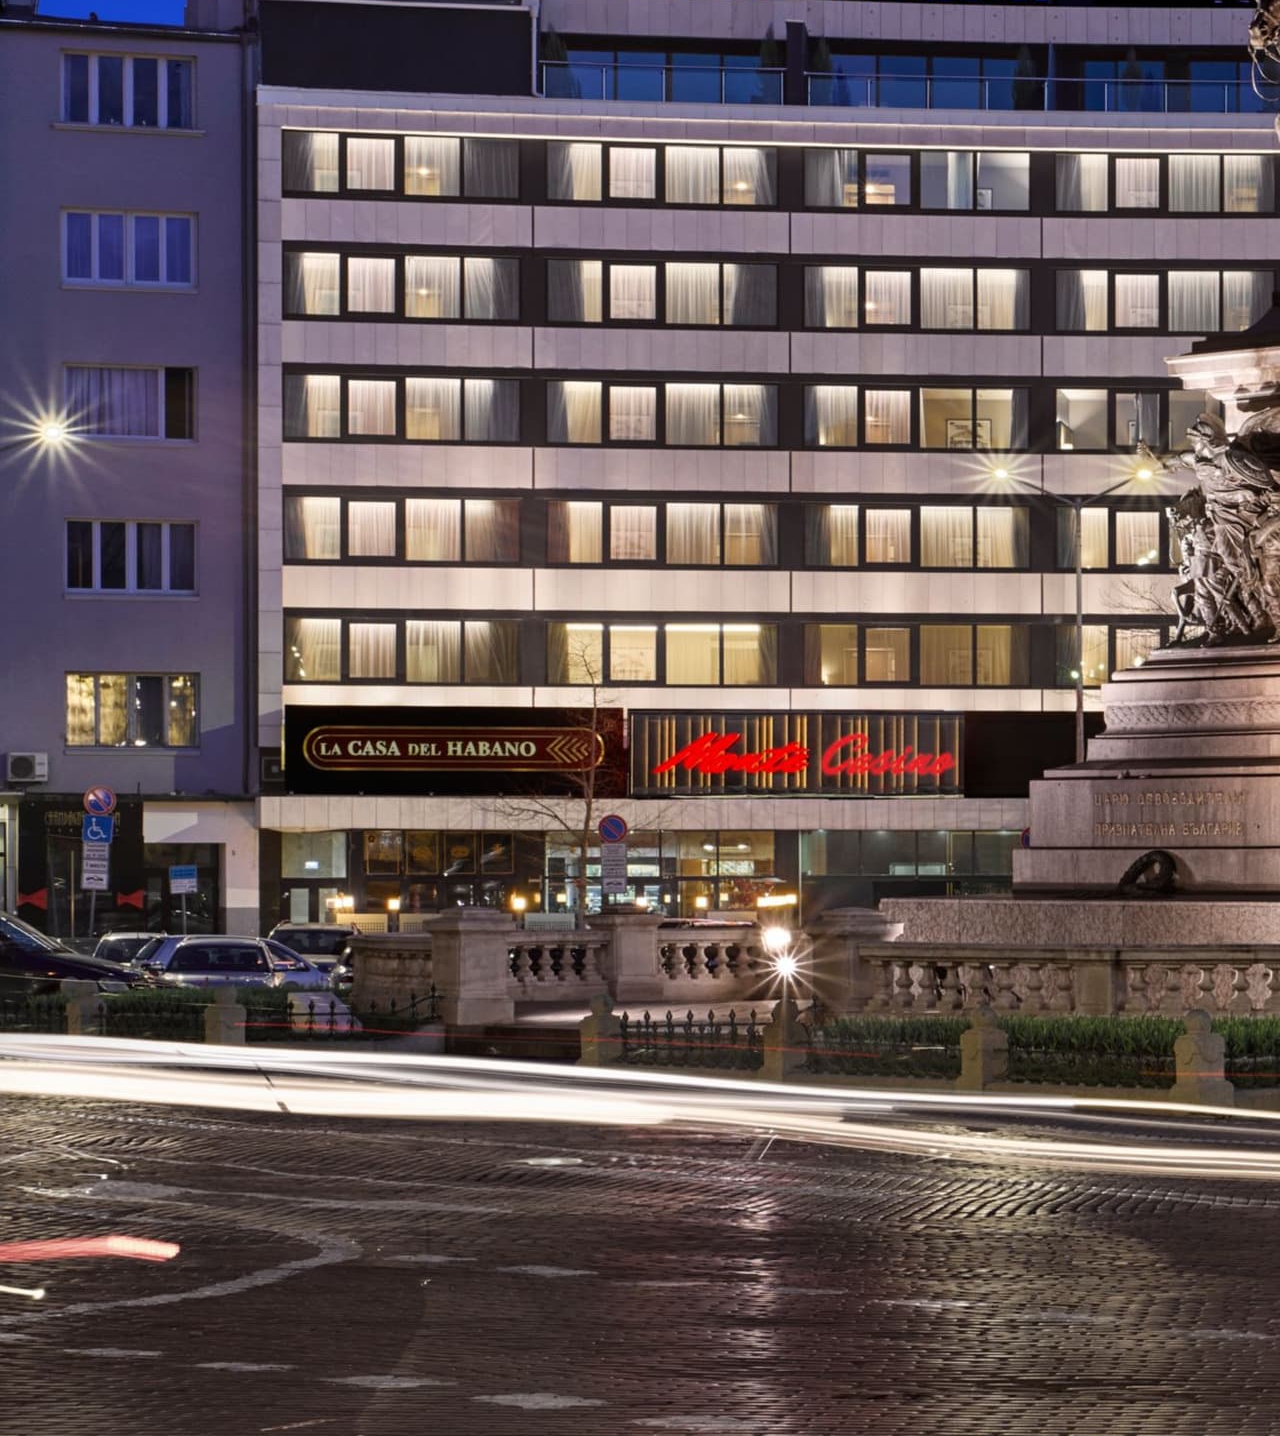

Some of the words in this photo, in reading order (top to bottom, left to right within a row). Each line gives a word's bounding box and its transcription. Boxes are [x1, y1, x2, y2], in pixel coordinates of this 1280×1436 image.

[320, 742, 342, 756] LA
[347, 740, 401, 757] CASA
[408, 743, 441, 756] DEL
[447, 741, 537, 757] HABANO
[653, 731, 810, 774] Monte
[822, 732, 956, 776] Casino
